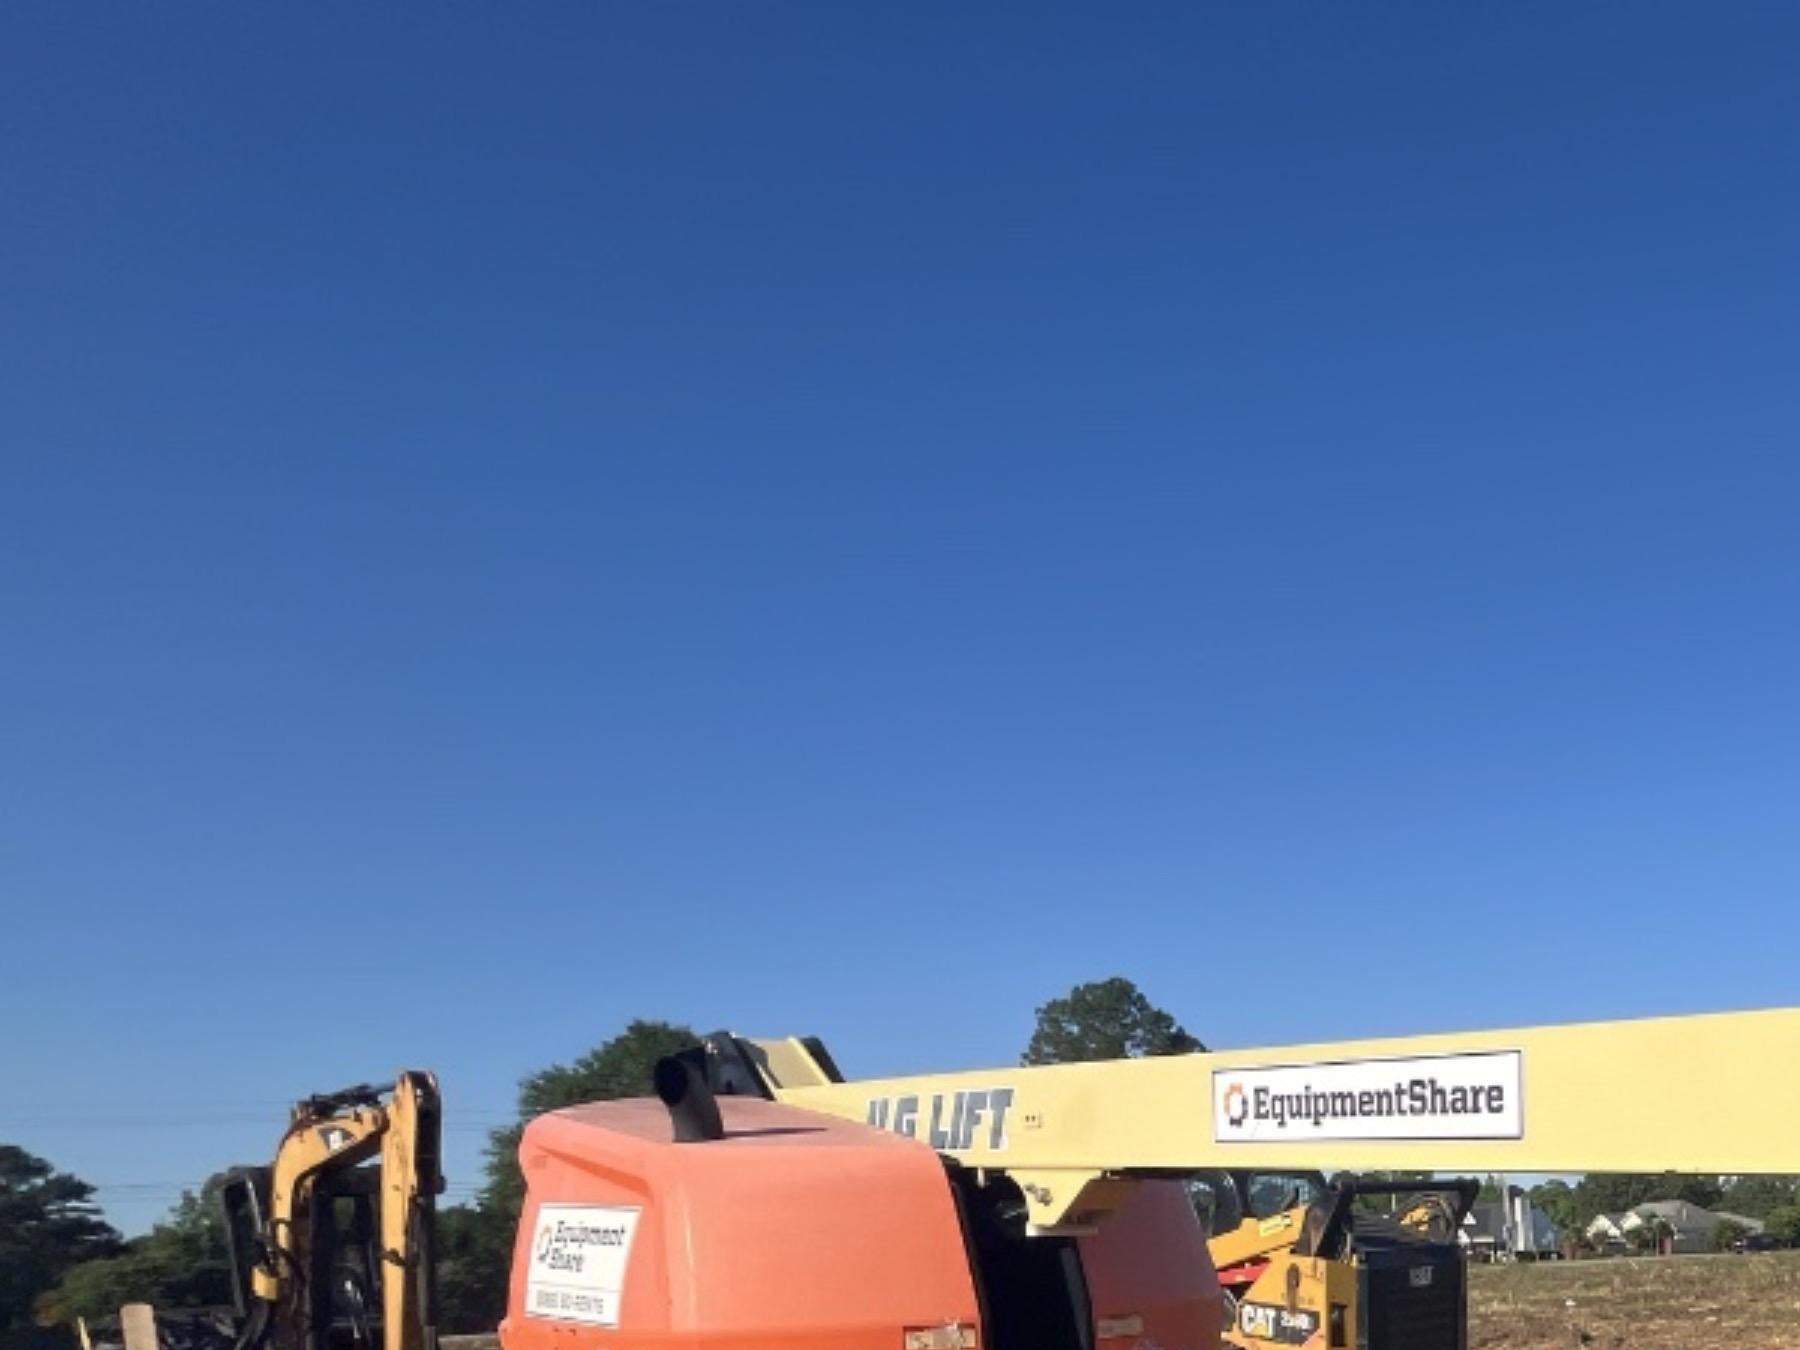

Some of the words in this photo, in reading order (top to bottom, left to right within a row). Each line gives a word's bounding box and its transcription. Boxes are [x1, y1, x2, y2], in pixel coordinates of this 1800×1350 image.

[929, 1088, 1015, 1150] LIFT
[1253, 1077, 1505, 1128] EquipmentShare
[1241, 1303, 1277, 1338] CAT
